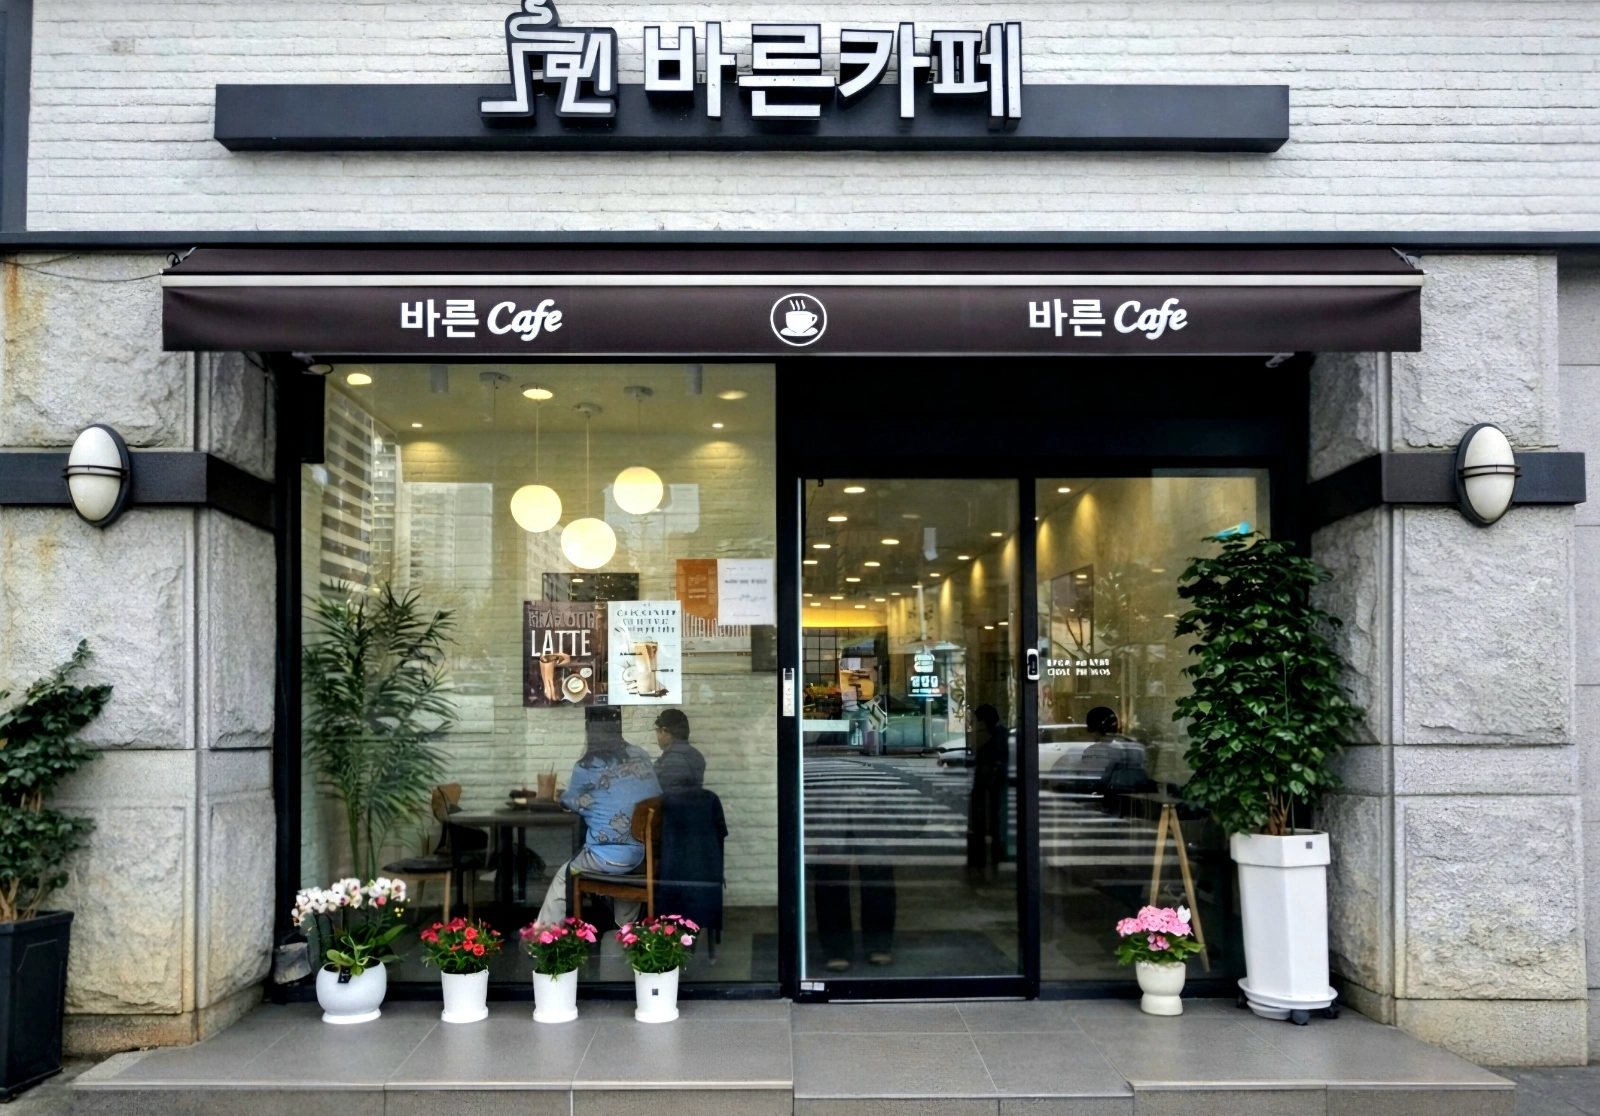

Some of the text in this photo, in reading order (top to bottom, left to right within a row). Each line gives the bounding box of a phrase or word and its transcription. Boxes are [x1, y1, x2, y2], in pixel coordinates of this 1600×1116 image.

[643, 21, 1022, 119] 바른카페
[401, 298, 563, 342] 바른 Cafe
[1029, 298, 1188, 340] 바른 Cafe
[531, 629, 592, 657] LATTE
